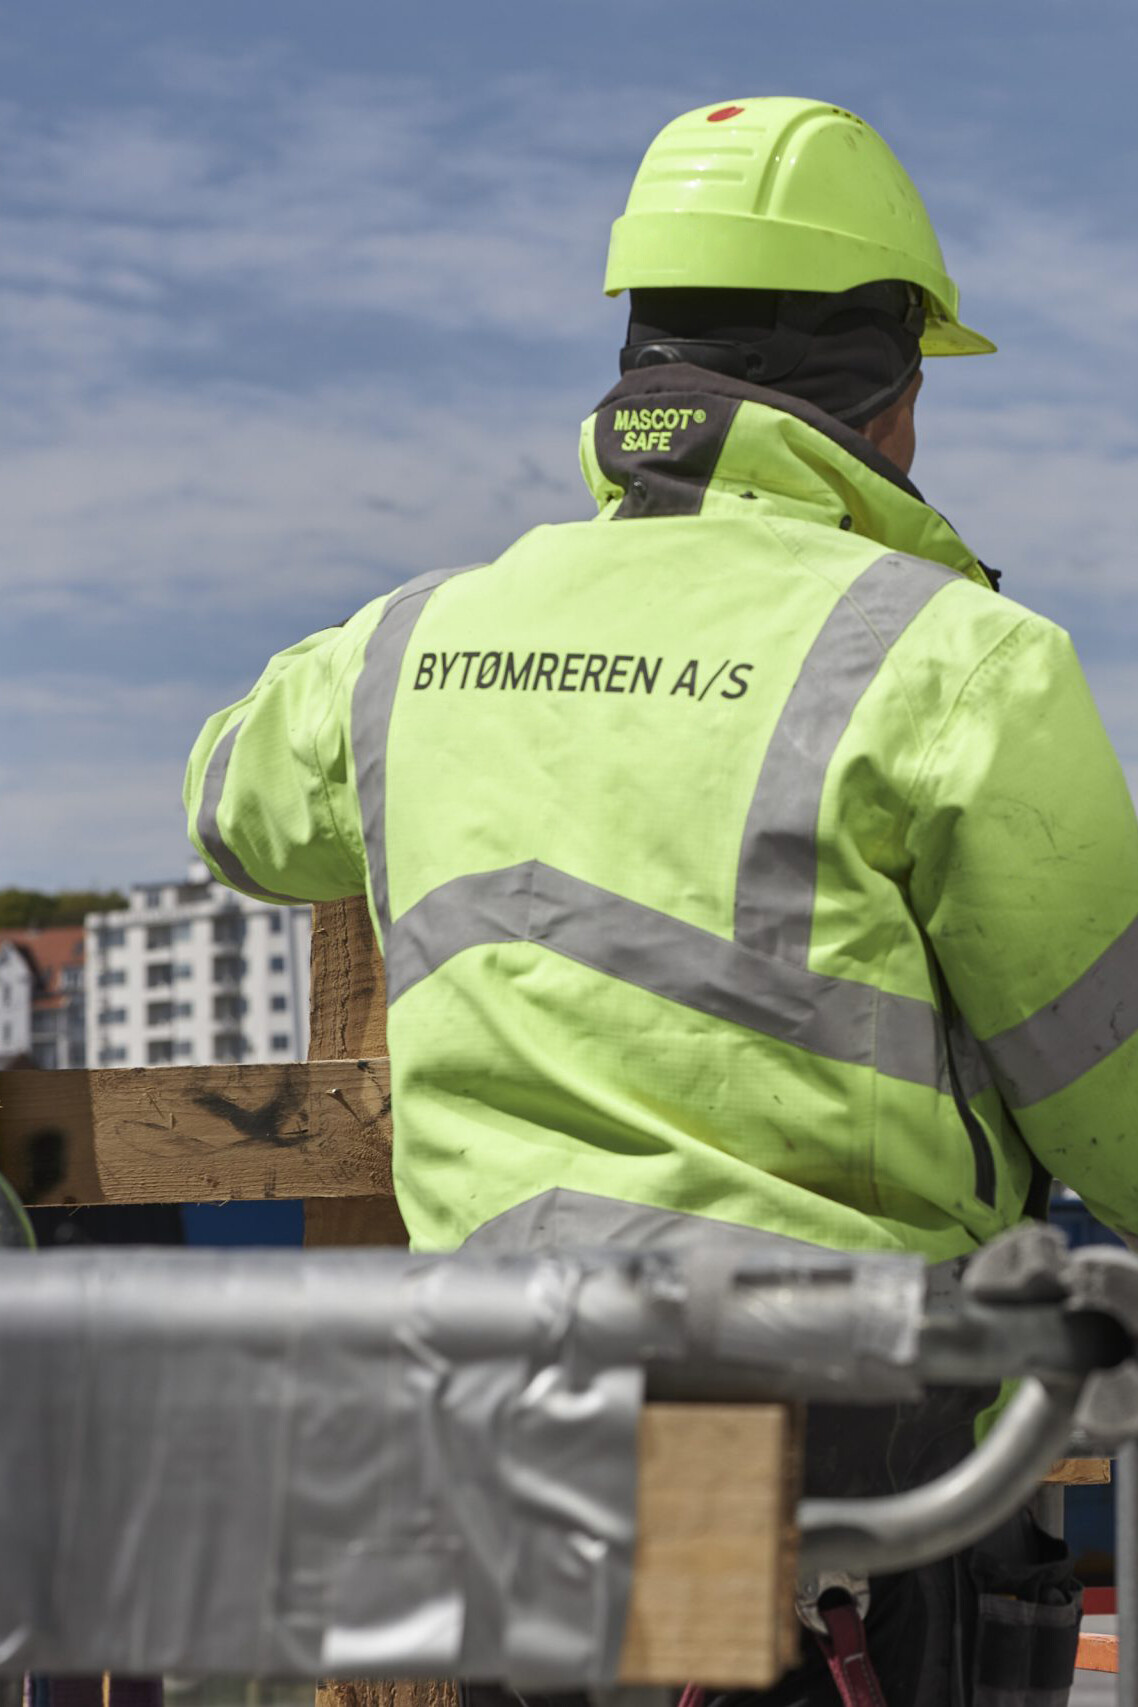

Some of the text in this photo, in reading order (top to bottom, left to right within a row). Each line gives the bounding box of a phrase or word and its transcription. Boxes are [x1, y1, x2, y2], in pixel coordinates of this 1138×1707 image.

[621, 432, 672, 451] SAFE
[413, 651, 754, 701] BYTØMREREN A/S
